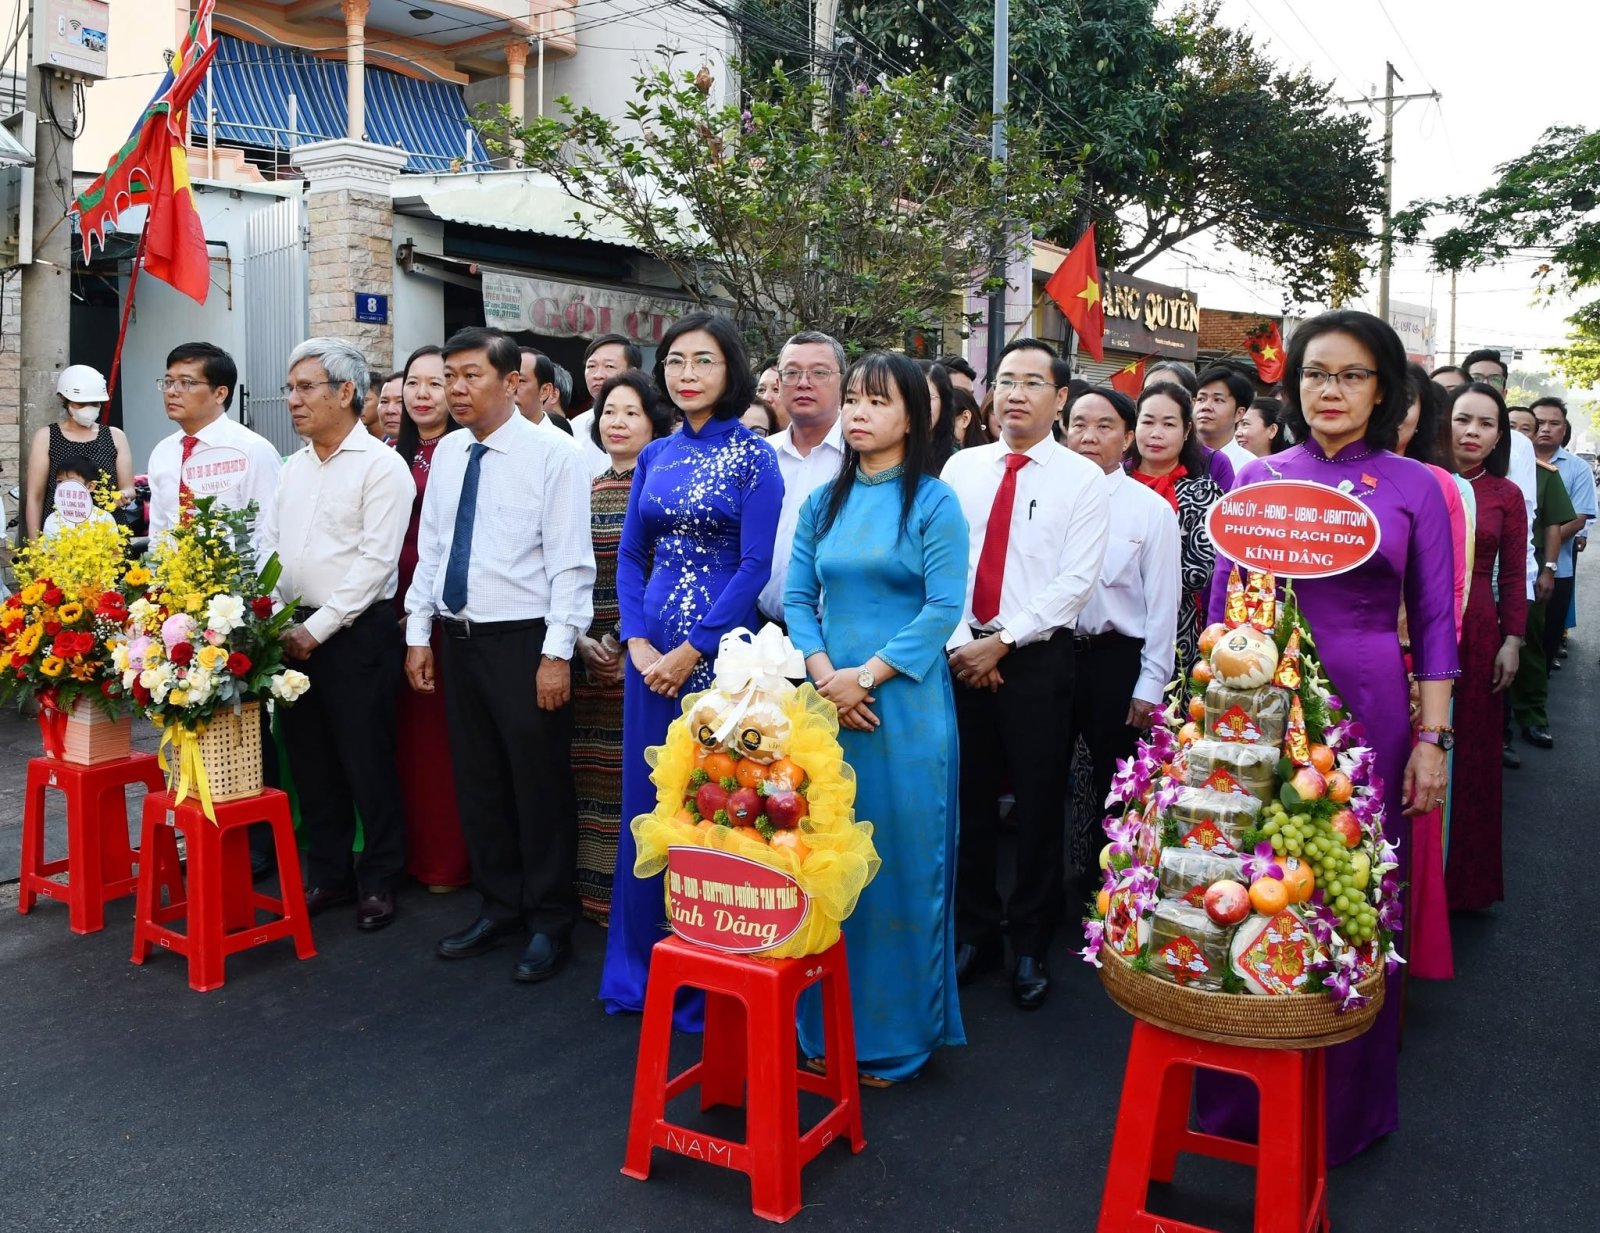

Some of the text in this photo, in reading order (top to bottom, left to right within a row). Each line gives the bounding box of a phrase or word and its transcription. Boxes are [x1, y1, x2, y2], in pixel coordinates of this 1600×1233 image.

[367, 297, 377, 313] 8
[1144, 291, 1200, 333] QUYÊN
[1222, 498, 1245, 516] ĐẢNG
[1245, 499, 1257, 517] ỦY
[1264, 504, 1287, 520] HĐND
[1294, 507, 1318, 522] UBND
[1323, 509, 1368, 528] UBMTTQVN
[1224, 524, 1366, 546] PHƯỜNG RẠCH DỪA
[1245, 544, 1334, 567] KÍNH DÂNG
[713, 909, 780, 946] Dâng
[666, 1130, 731, 1168] NAM
